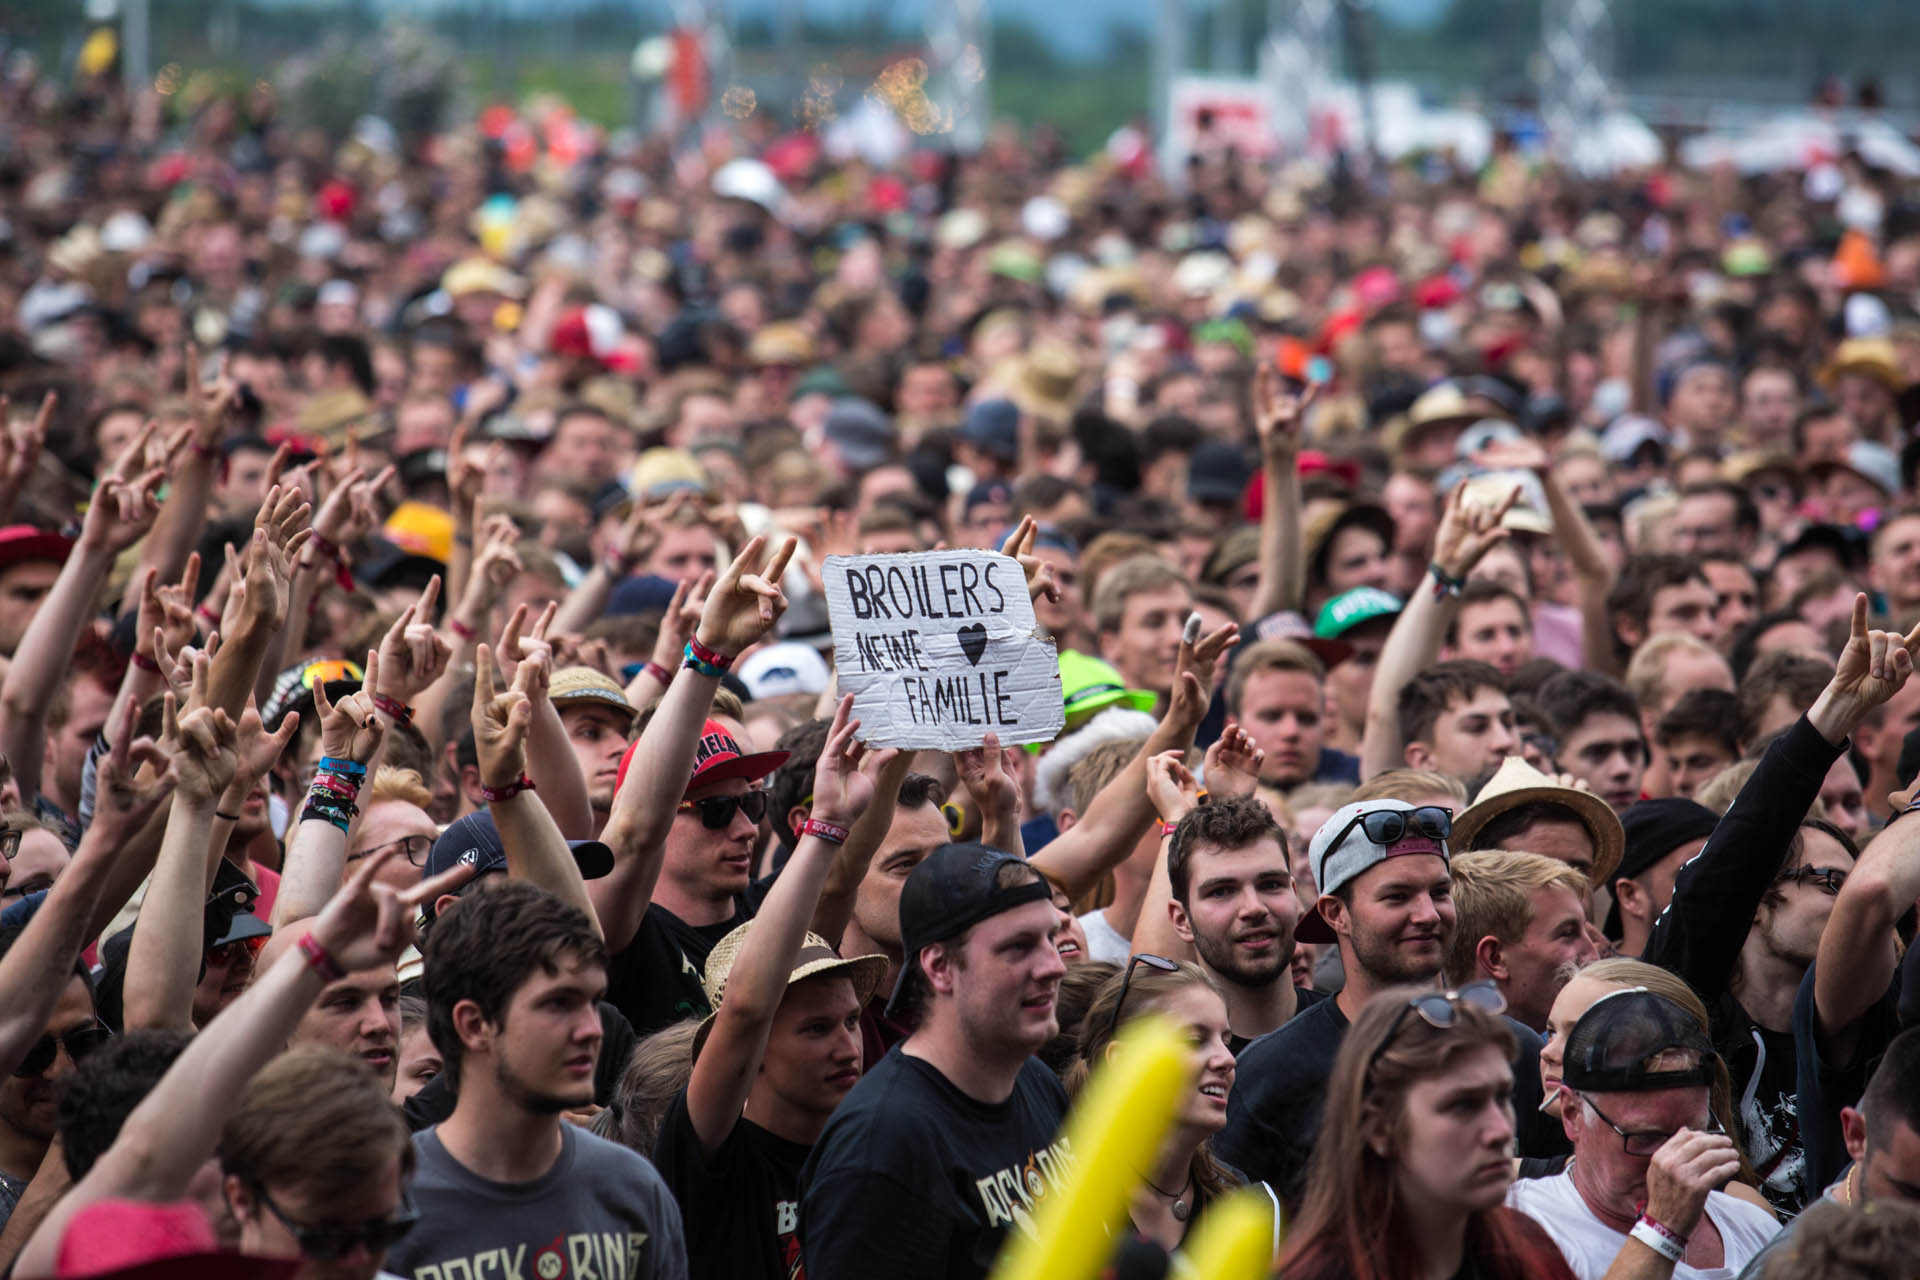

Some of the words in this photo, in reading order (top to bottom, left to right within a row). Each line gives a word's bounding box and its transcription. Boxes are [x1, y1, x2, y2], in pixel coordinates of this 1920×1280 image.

[846, 562, 1005, 619] BROILERS
[856, 629, 929, 672] MEINE
[903, 671, 1018, 726] FAMILIE
